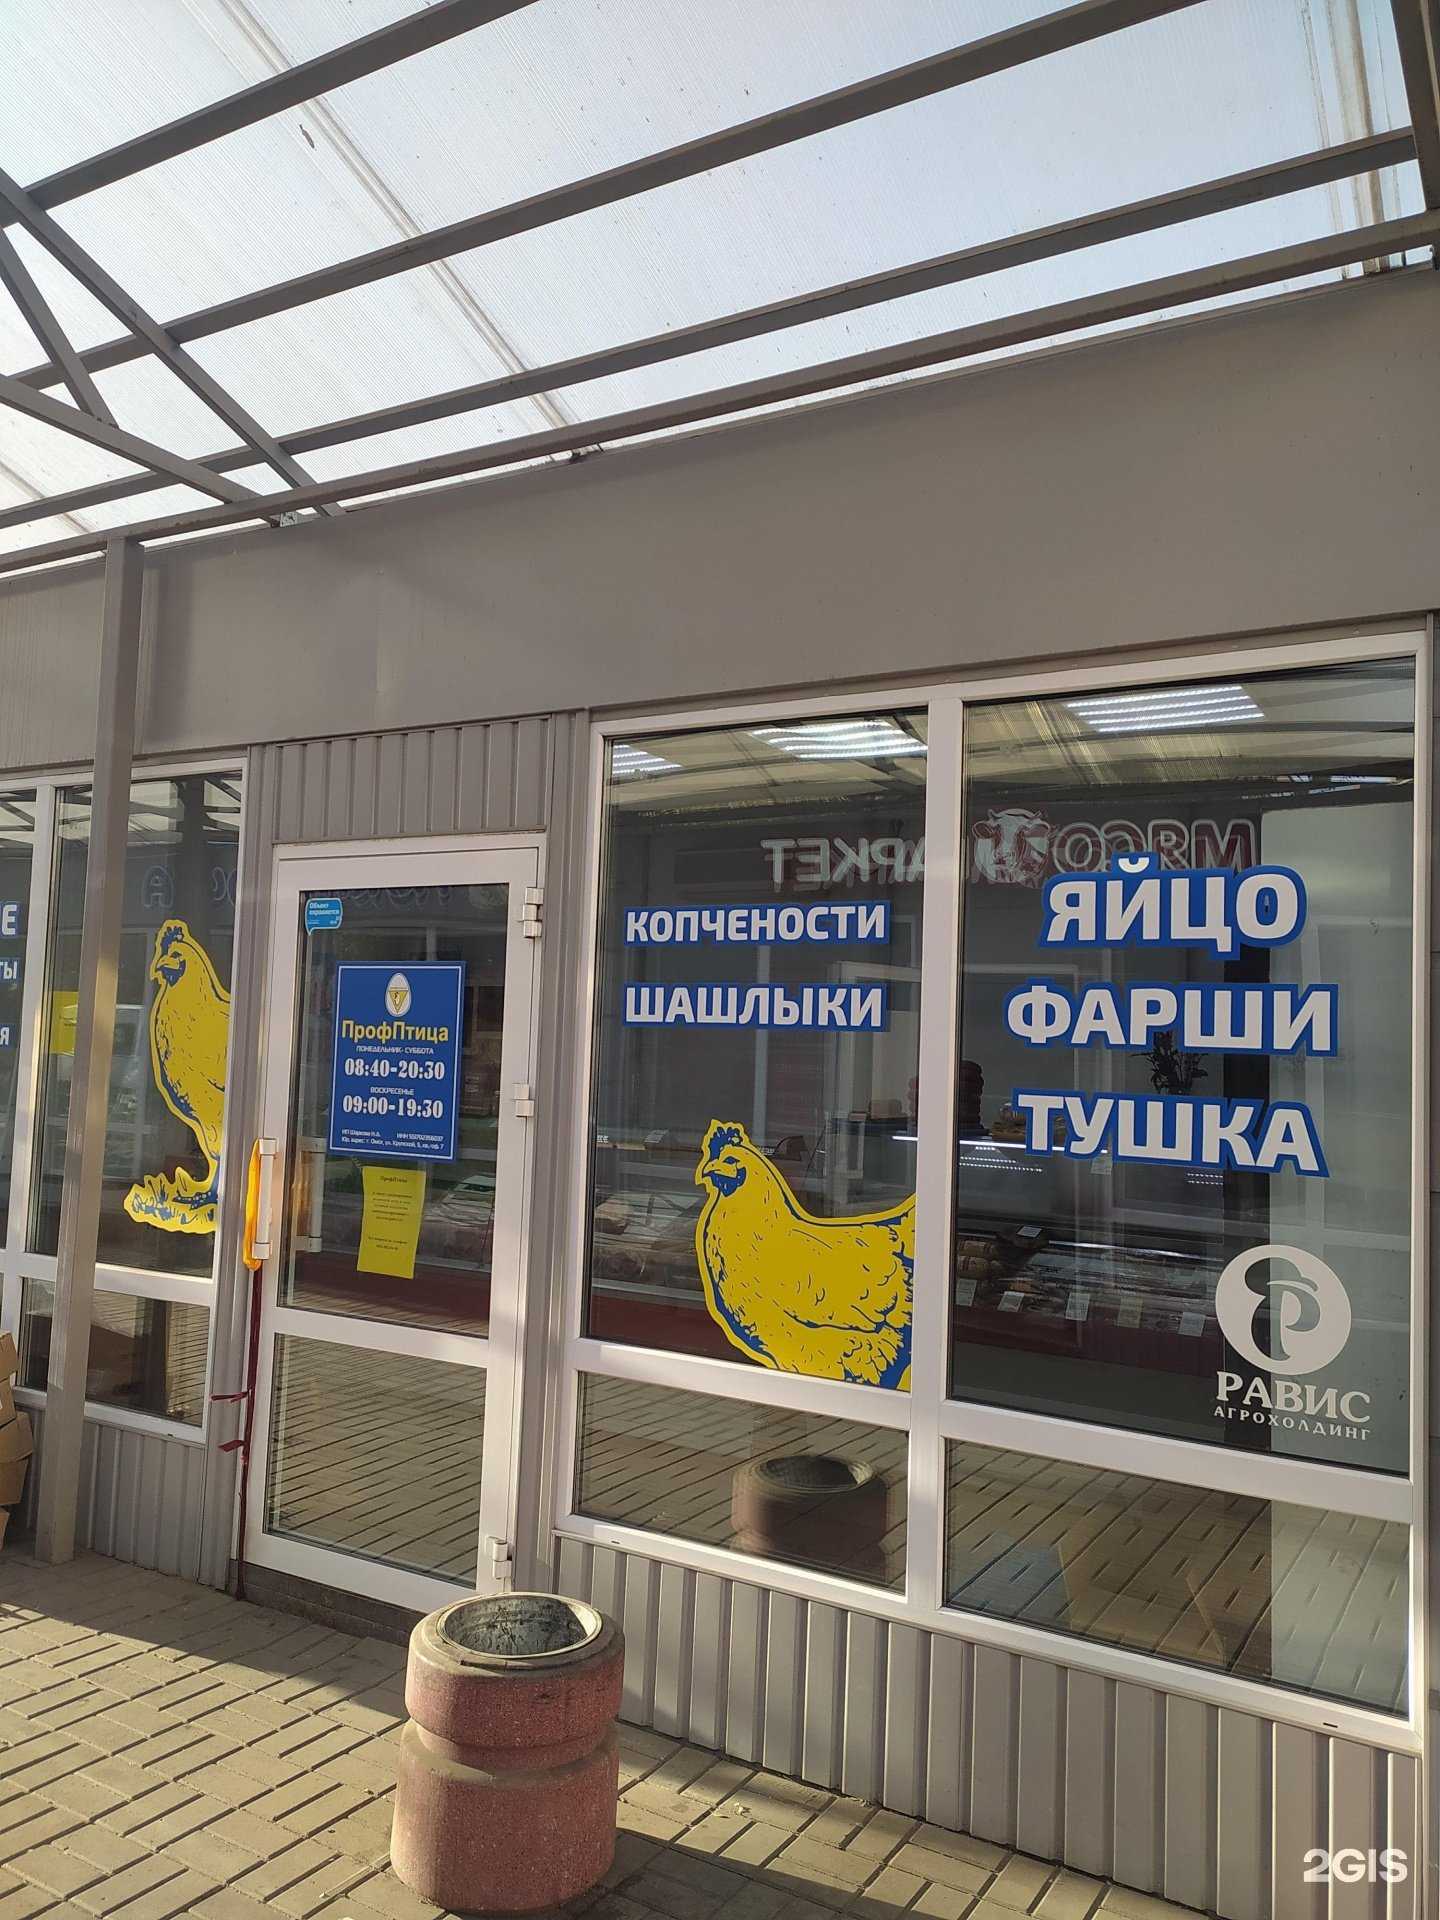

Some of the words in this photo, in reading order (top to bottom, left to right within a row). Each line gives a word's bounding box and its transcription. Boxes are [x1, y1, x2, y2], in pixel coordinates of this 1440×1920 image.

[625, 904, 886, 943] КОПЧЕНОСТИ
[1046, 856, 1299, 953] ЯЙЦО
[625, 986, 883, 1028] ШАШЛЫКИ
[1006, 984, 1332, 1051] ФАРШИ
[341, 1020, 449, 1045] ПрофПтица
[344, 1058, 446, 1080] 08:40-20:30
[342, 1095, 444, 1119] 09:00-19:30
[1017, 1093, 1320, 1171] ТУШКА
[1216, 1370, 1371, 1424] РАВИС
[1214, 1404, 1371, 1442] АГРОХОЛДИНГ
